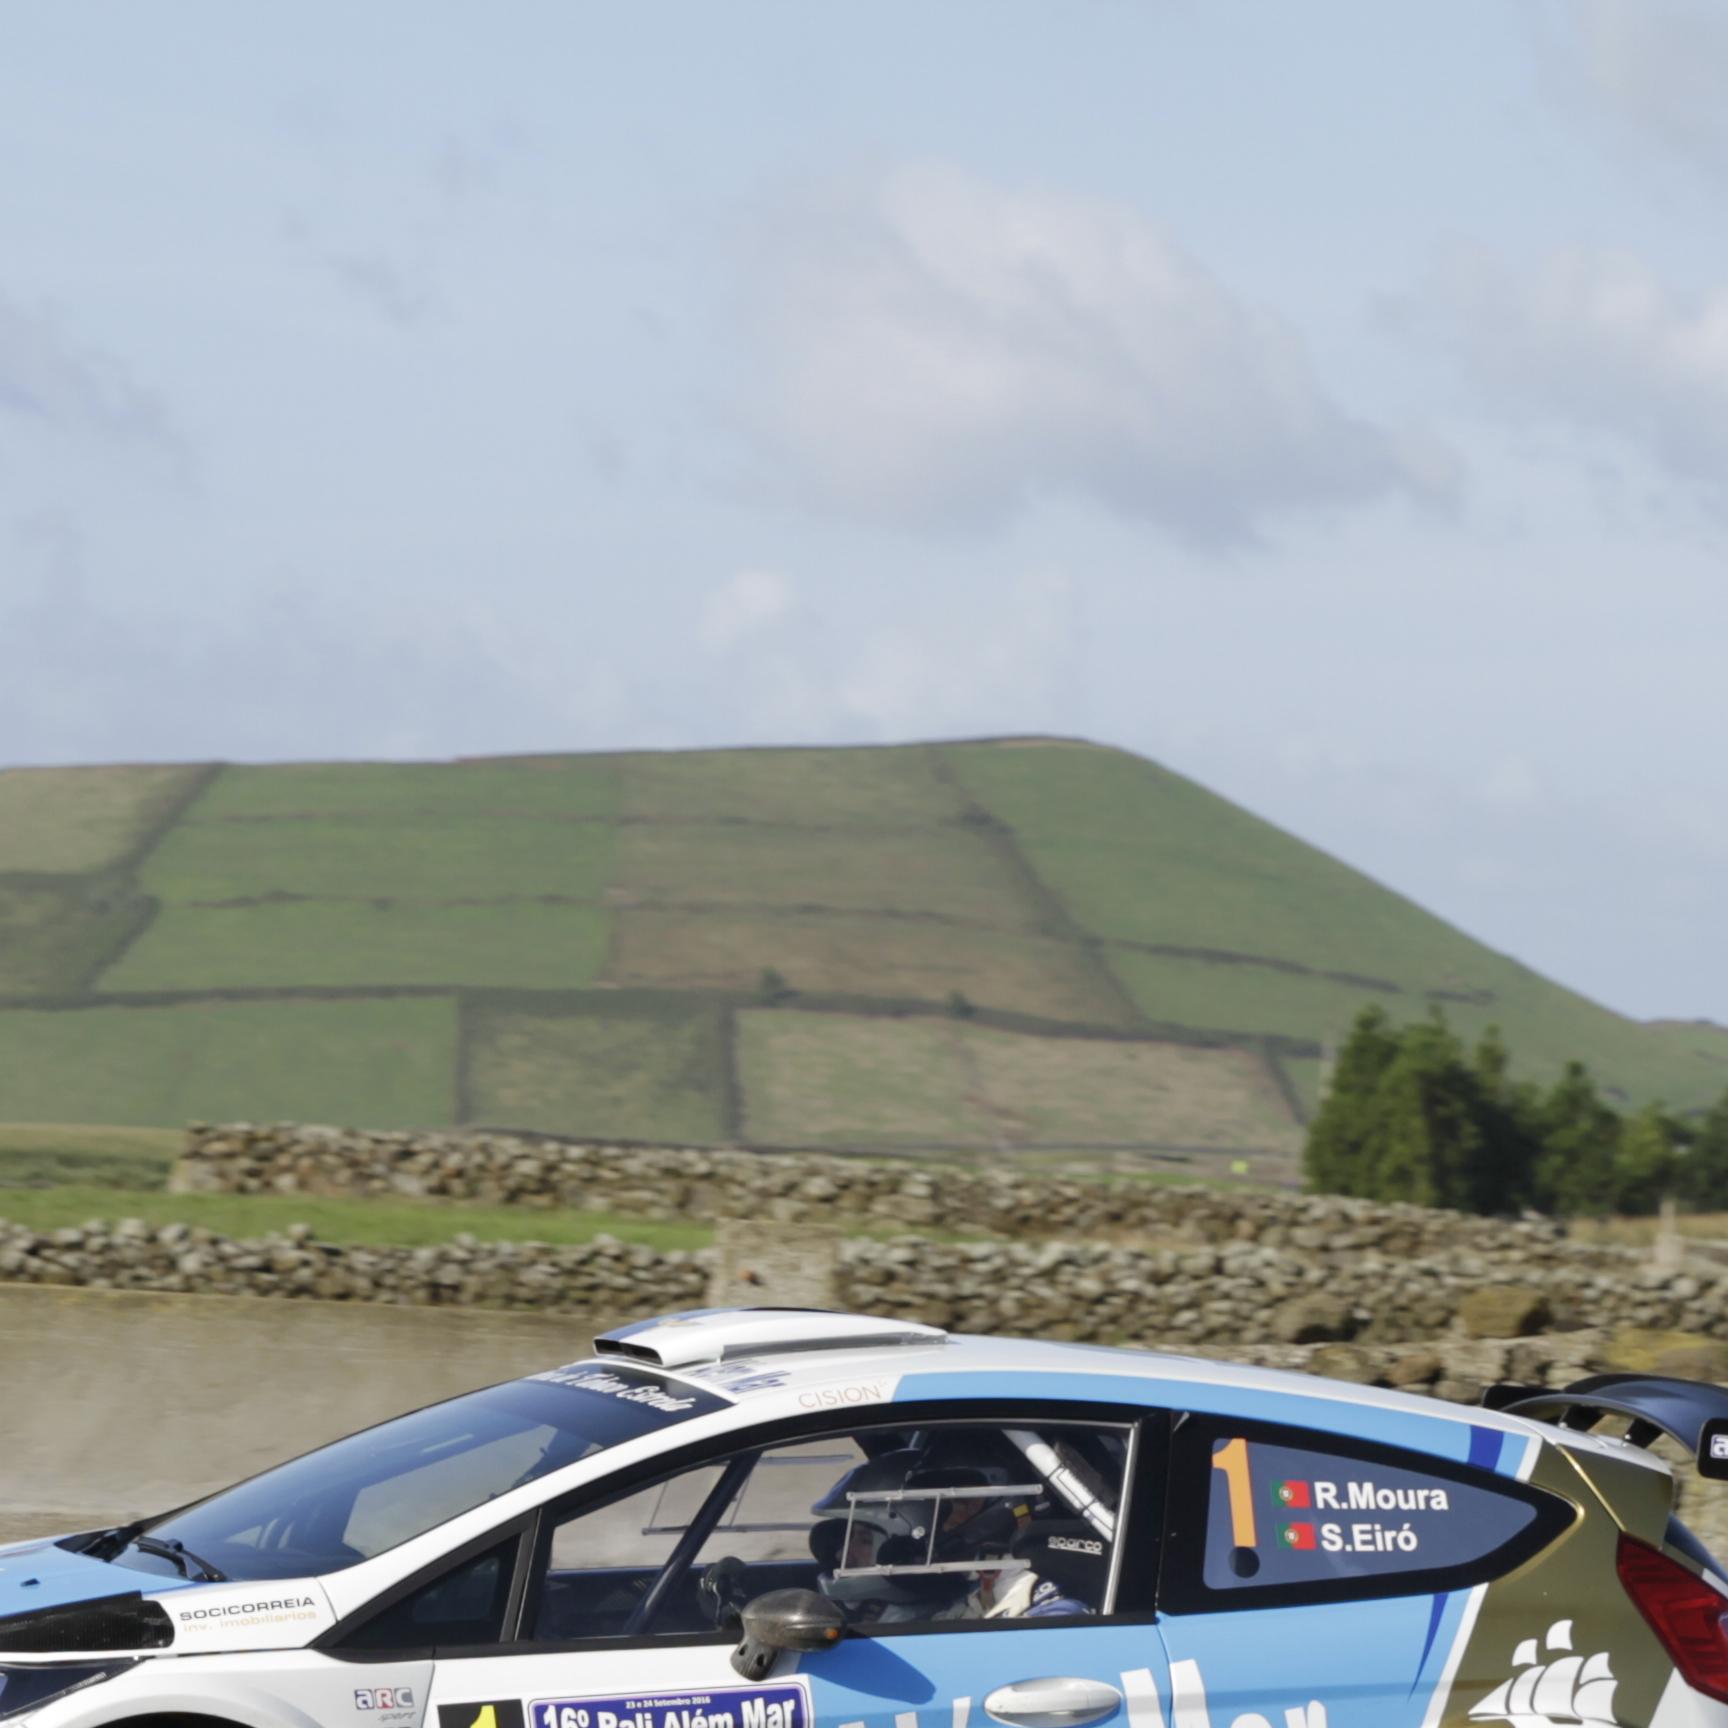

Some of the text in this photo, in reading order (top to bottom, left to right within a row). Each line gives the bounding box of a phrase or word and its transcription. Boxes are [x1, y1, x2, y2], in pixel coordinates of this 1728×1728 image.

[1211, 1438, 1256, 1547] 1
[1314, 1481, 1449, 1510] R.Moura
[1321, 1522, 1418, 1552] S.Eiró
[179, 1597, 315, 1621] SOCICORREIA
